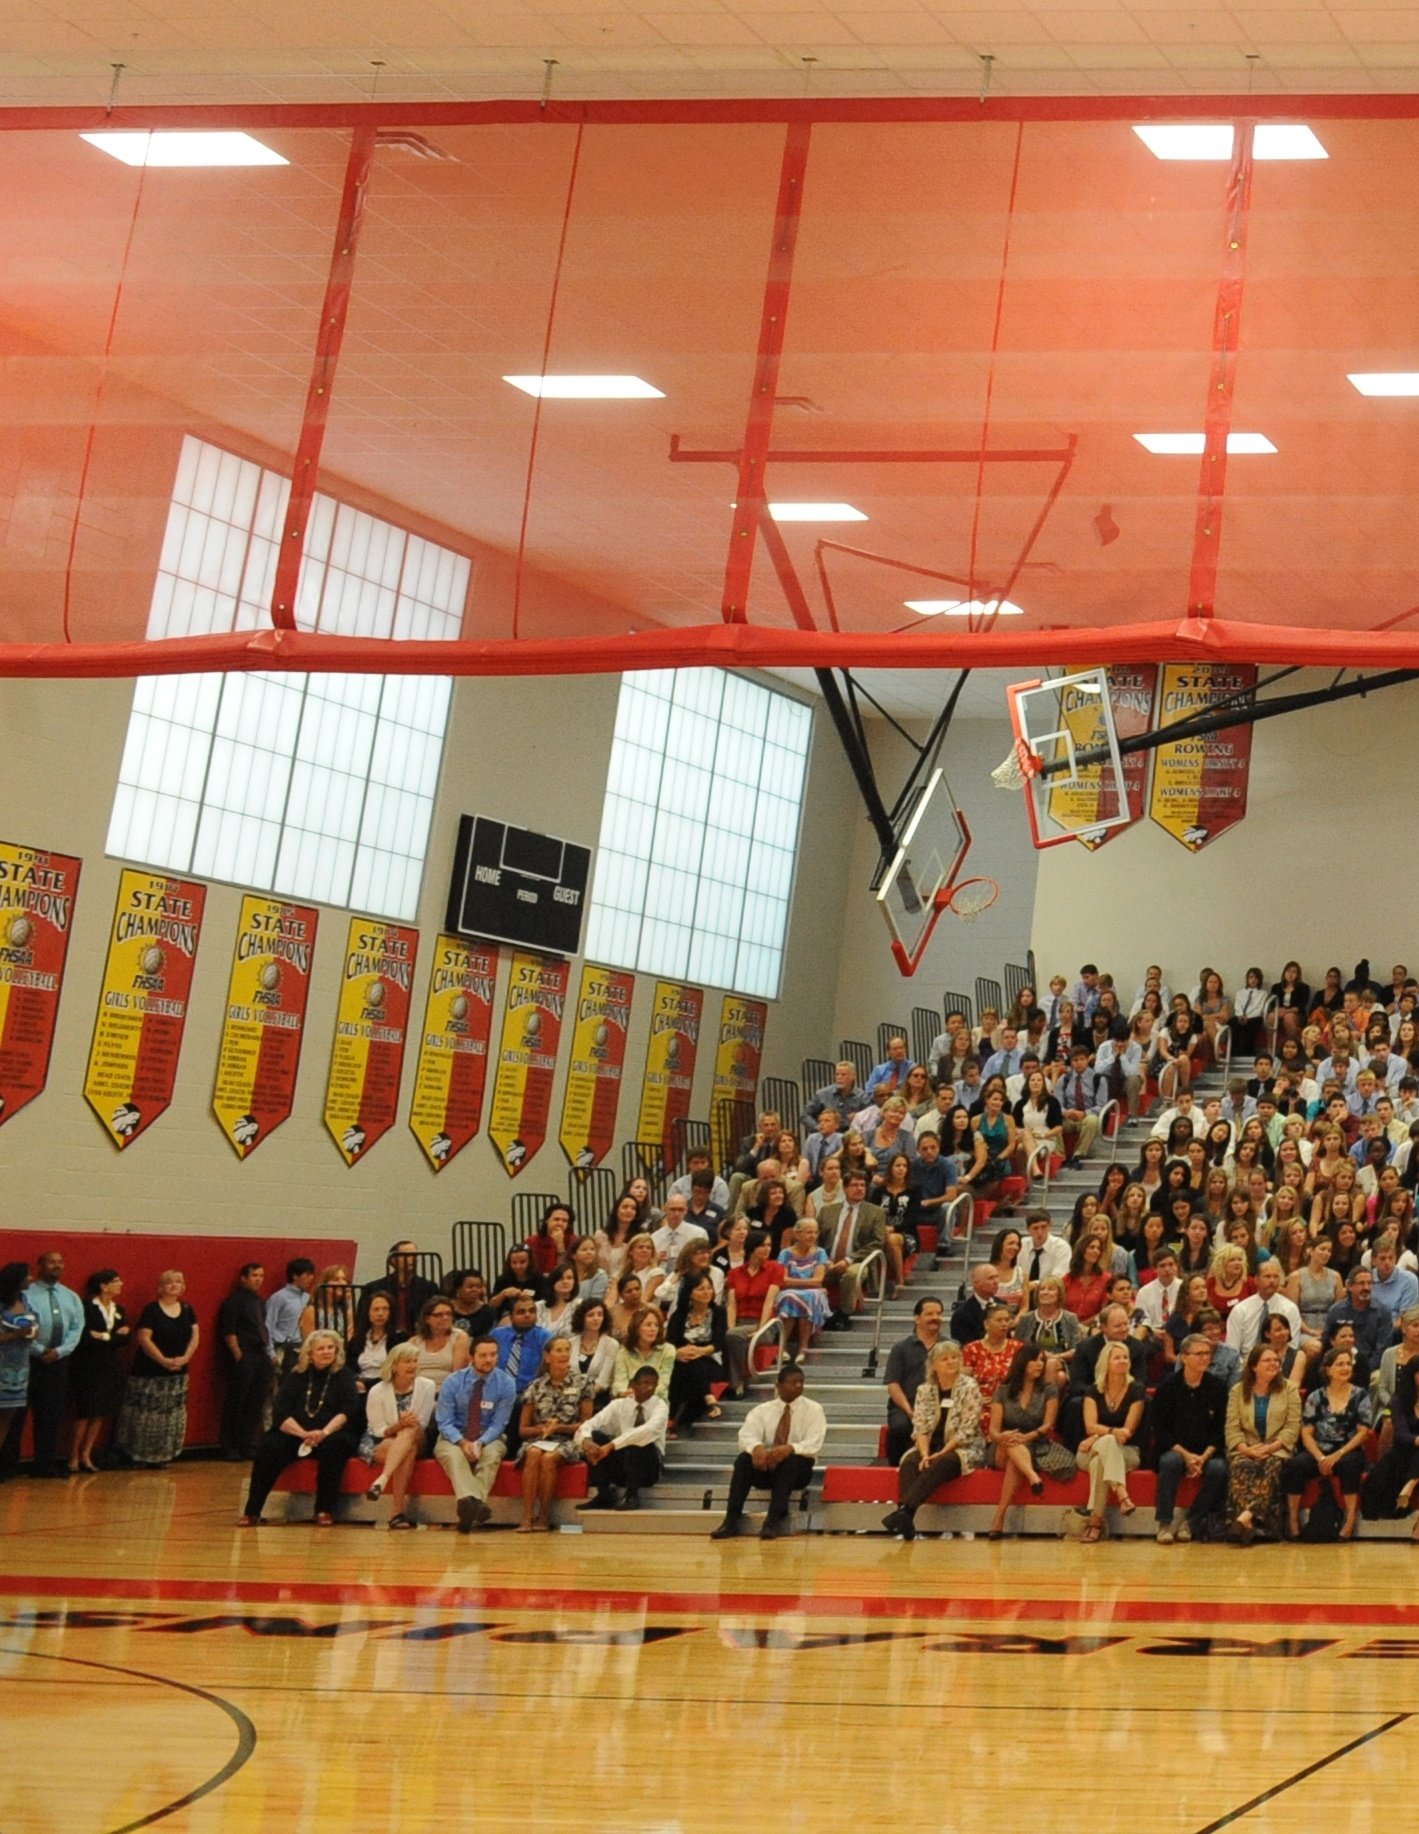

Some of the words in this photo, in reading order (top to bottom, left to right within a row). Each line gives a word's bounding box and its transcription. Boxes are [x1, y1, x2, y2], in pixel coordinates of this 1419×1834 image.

[1176, 676, 1241, 690] STATE
[1174, 744, 1234, 755] ROWING
[1161, 758, 1200, 769] WOMENS
[1160, 788, 1203, 798] WOMENS
[0, 861, 65, 891] STATE
[475, 865, 502, 886] HOME
[131, 891, 193, 919] STATE
[553, 885, 581, 906] GUEST
[116, 911, 199, 958] CHAMPIONS
[251, 913, 305, 940] STATE
[239, 932, 310, 975] CHAMPIONS
[358, 934, 409, 960] STATE
[347, 952, 414, 992] CHAMPIONS
[443, 951, 489, 974] STATE
[0, 967, 59, 991] OLLEYBALL
[132, 975, 166, 993] FHSAA
[434, 969, 494, 1005] CHAMPIONS
[520, 967, 560, 989] STATE
[510, 985, 564, 1021] CHAMPIONS
[588, 981, 625, 1003] STATE
[105, 991, 130, 1010] GIRLS
[133, 995, 186, 1017] VOLLEYBALL
[229, 1005, 251, 1022] GIRLS
